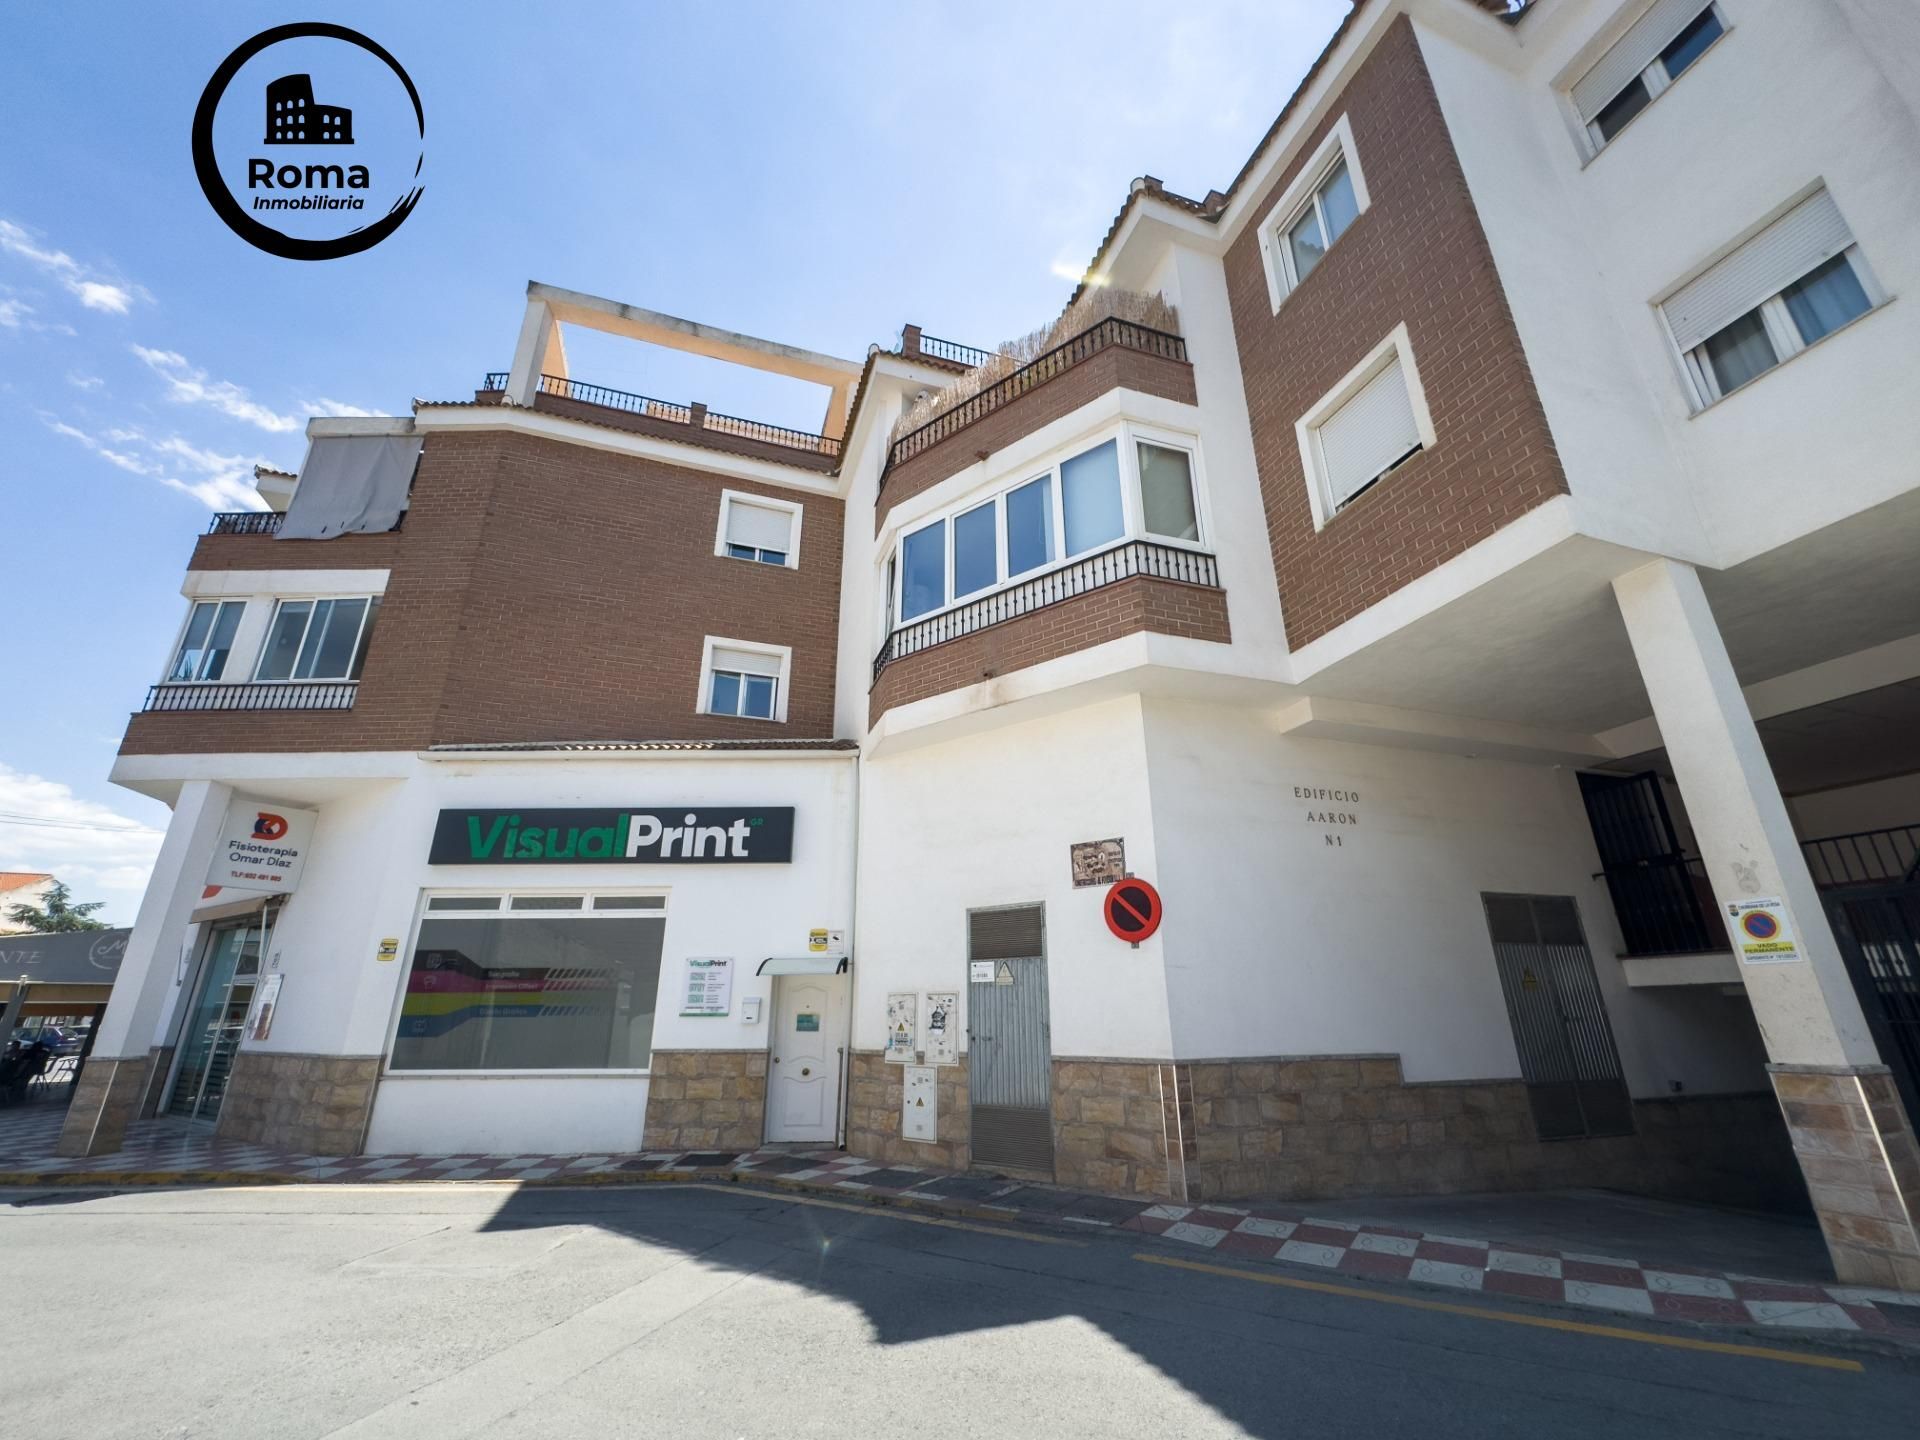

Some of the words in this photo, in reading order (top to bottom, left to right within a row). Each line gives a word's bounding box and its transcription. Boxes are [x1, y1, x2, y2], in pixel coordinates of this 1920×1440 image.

[1294, 786, 1359, 802] EDIFICIO
[1307, 811, 1357, 825] AARON
[467, 813, 751, 859] VisualPrint
[228, 840, 298, 858] Fisioterapia
[229, 852, 264, 865] Omar
